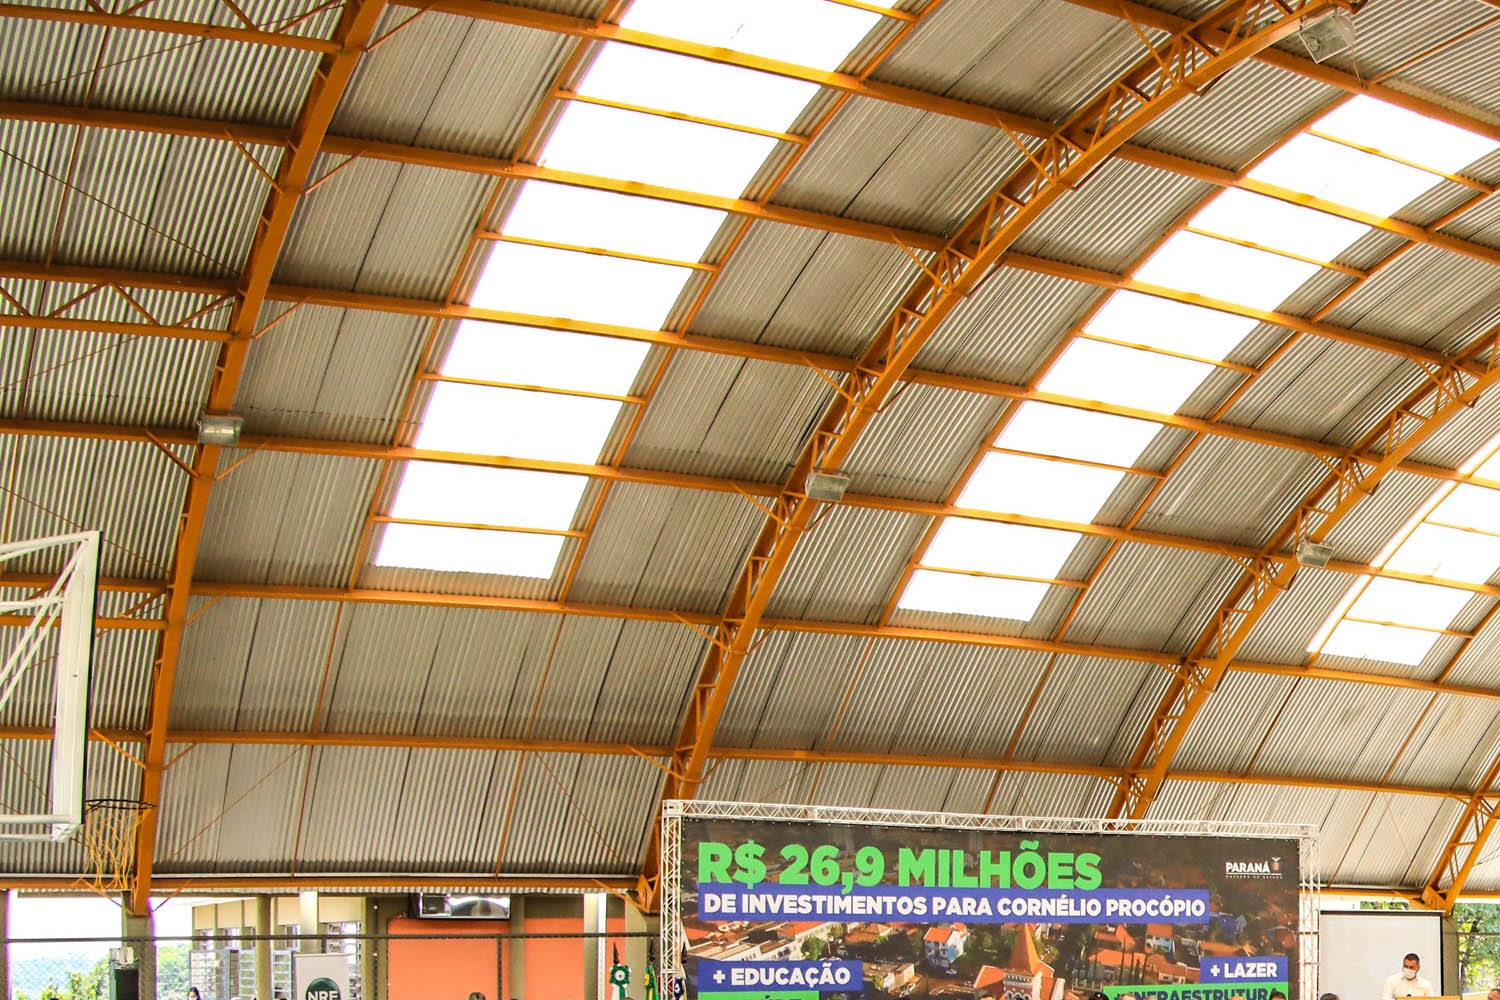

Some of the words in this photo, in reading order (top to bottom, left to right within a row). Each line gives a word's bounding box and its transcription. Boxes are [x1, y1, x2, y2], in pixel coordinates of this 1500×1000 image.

[699, 840, 767, 889] R$
[779, 844, 885, 894] 26,9
[899, 839, 1102, 891] MILHÕES
[1225, 861, 1271, 873] PARANÁ
[704, 893, 736, 914] DE
[742, 894, 928, 916] INVESTIMENTOS
[934, 897, 993, 916] PARA
[997, 894, 1101, 917] CORNÉLIO
[1106, 895, 1206, 917] PROCÓPIO
[731, 962, 851, 989] EDUCAÇÃO
[1224, 963, 1278, 978] LAZER
